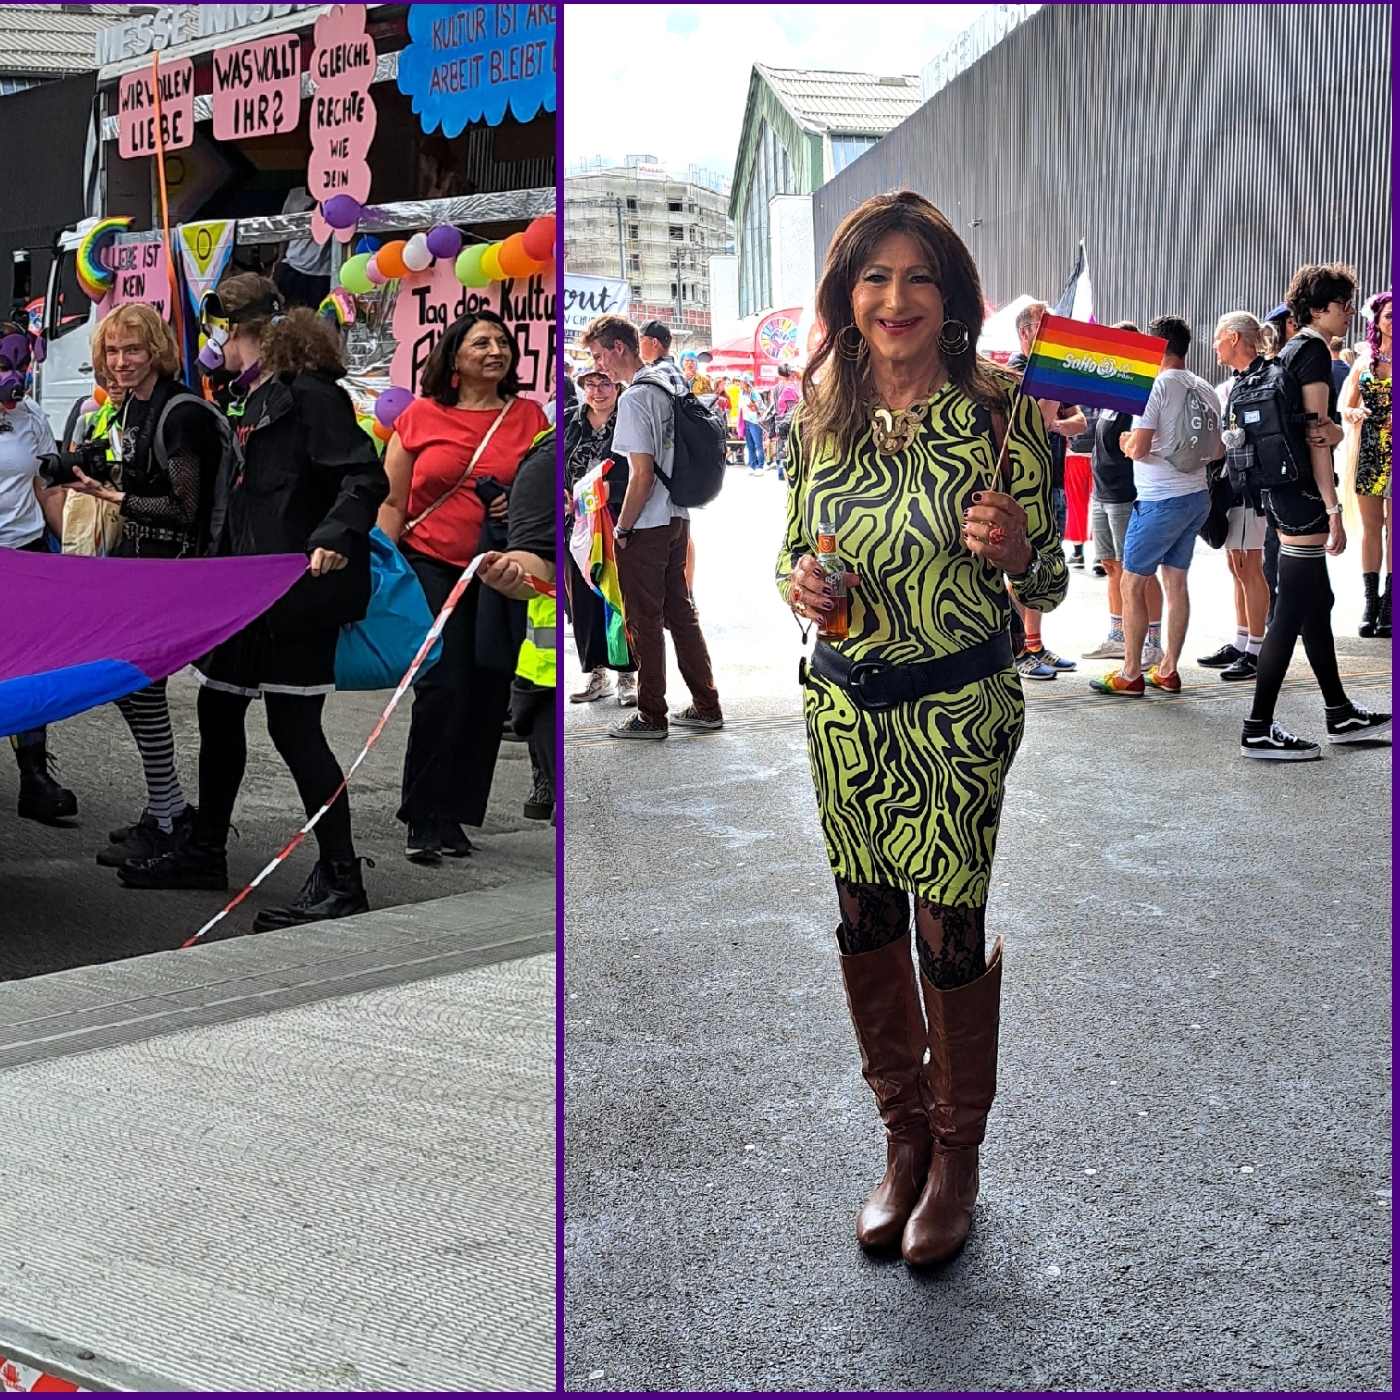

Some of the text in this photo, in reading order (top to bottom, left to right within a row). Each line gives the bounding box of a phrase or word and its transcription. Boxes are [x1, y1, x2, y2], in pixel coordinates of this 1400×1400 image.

[94, 4, 190, 66] MESSE
[432, 6, 487, 51] KULTUR
[214, 39, 300, 92] WAS WOLLT
[317, 42, 370, 78] GLEICHE
[429, 54, 485, 96] ARBEIT
[490, 40, 548, 85] BLEIBT
[121, 79, 144, 112] WIR
[234, 89, 284, 135] IHR?
[317, 90, 366, 130] RECHTE
[132, 110, 183, 152] LIEBE
[330, 137, 349, 159] WIE
[142, 243, 161, 268] IST
[412, 285, 448, 330] Tag
